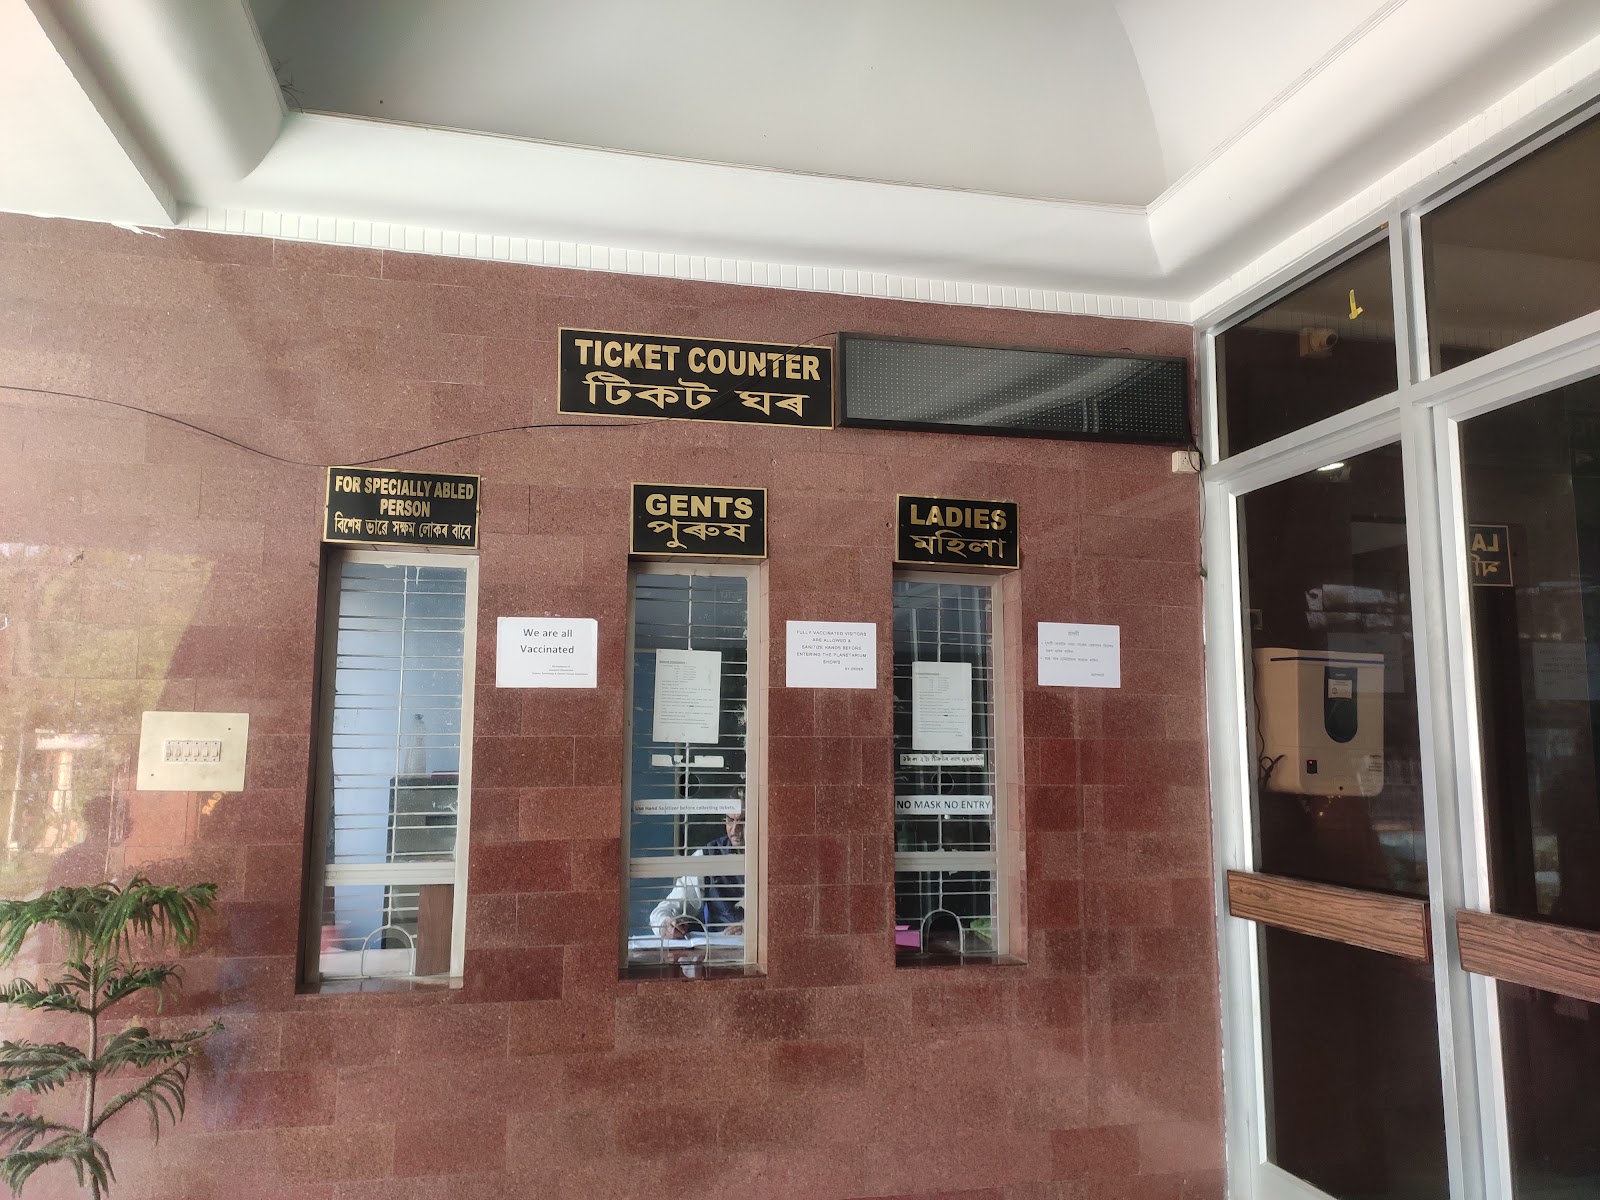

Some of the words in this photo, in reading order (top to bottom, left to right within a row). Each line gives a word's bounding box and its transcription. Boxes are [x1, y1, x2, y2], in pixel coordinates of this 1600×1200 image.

[574, 338, 681, 371] TICKET
[687, 347, 821, 381] COUNTER
[581, 370, 719, 410] টিকট
[734, 390, 810, 417] ঘৰ
[335, 475, 361, 493] FOR
[363, 477, 432, 498] SPECIALLY
[434, 481, 475, 500] ABLED
[379, 498, 431, 518] PERSON
[645, 493, 753, 520] GENTS
[910, 503, 1007, 531] LADIES
[334, 510, 363, 535] বিশেষ
[391, 520, 416, 538] সক্ষম
[647, 518, 751, 550] পুৰুষ
[909, 529, 1007, 559] মহিলা
[523, 628, 540, 637] We
[542, 630, 558, 638] are
[561, 629, 573, 638] all
[520, 644, 574, 654] Vaccinated
[896, 800, 912, 809] NO
[914, 800, 941, 809] MASK
[944, 801, 959, 809] NO
[961, 801, 991, 809] ENTRY
